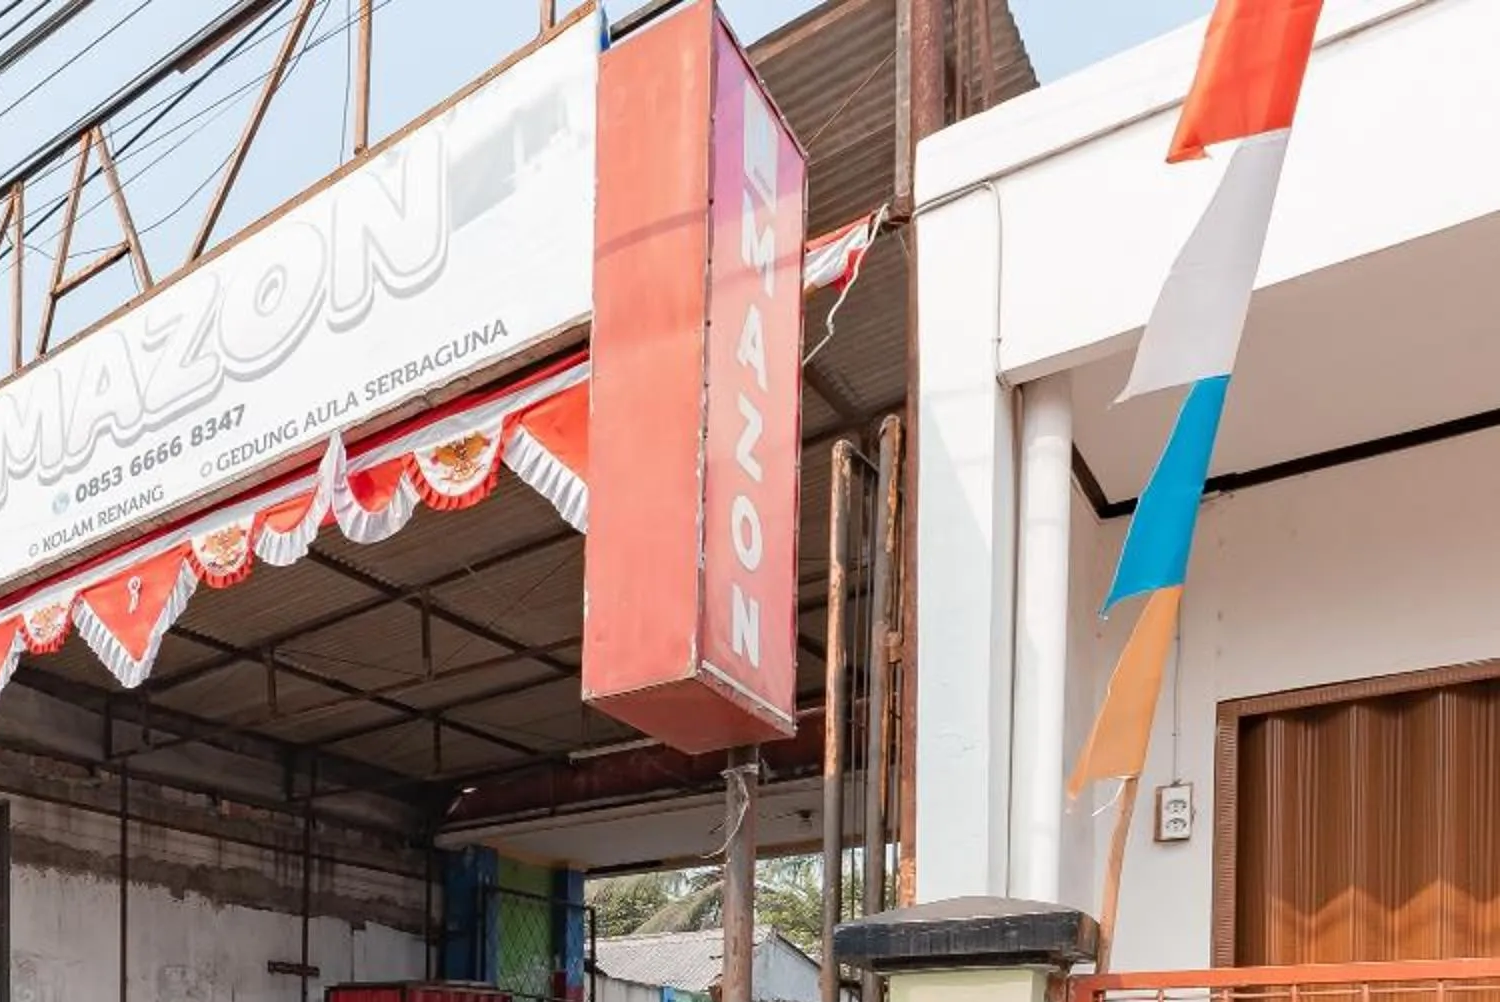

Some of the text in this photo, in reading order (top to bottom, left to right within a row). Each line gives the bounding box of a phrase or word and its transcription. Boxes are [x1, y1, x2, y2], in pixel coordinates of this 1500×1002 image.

[216, 318, 509, 472] GEDUNG AULA SERBAGUNA
[731, 80, 780, 668] MAZON
[74, 403, 246, 504] 0853 6666 8347
[42, 484, 165, 553] KOLAM RENANG
